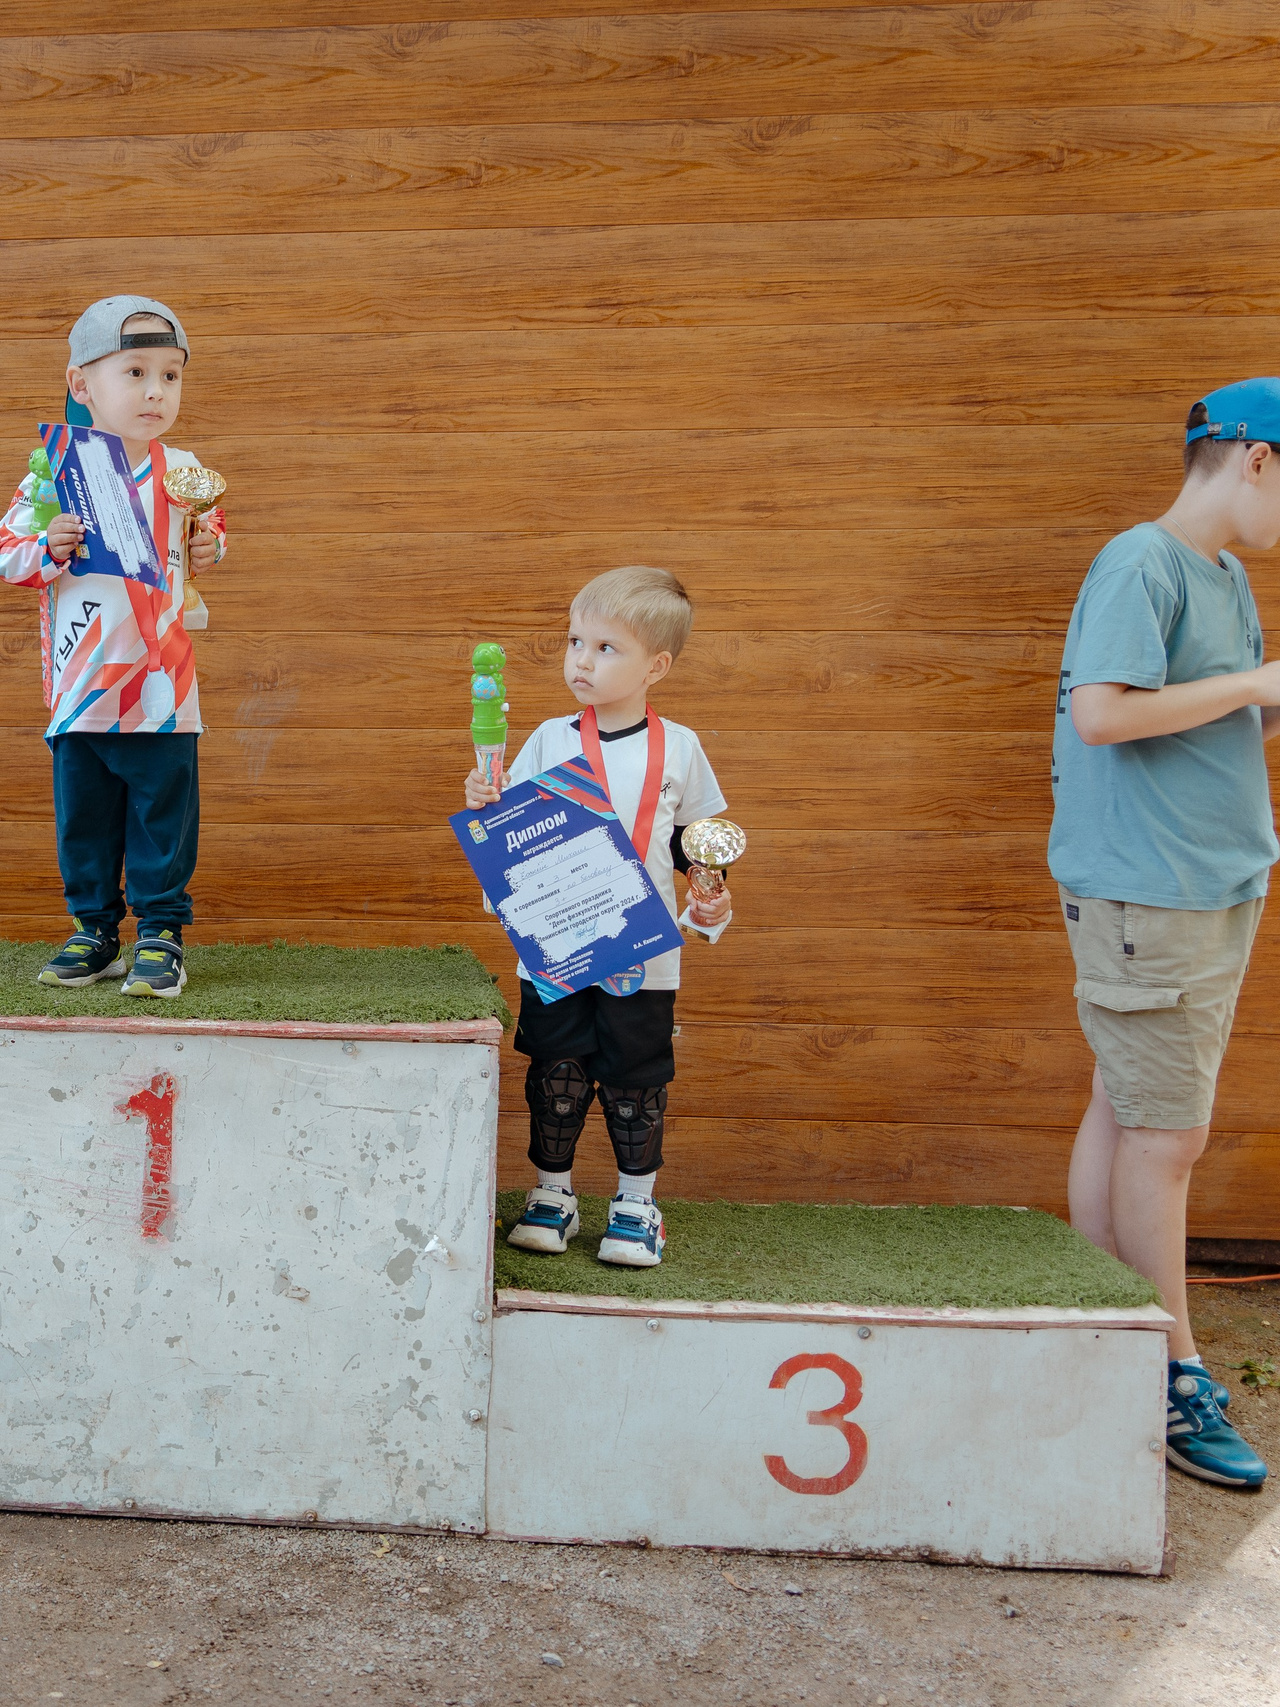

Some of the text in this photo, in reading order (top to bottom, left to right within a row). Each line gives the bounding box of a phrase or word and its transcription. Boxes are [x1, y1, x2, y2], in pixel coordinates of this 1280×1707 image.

[69, 467, 97, 535] Диплом
[505, 810, 568, 853] Диплом
[522, 834, 564, 858] награждается
[570, 863, 588, 874] место
[518, 889, 561, 912] соревнованиях
[537, 926, 569, 943] Ленинском
[569, 912, 600, 930] городском
[600, 903, 620, 916] округе
[620, 896, 634, 906] 2024
[544, 888, 612, 922] Спортивного праздника
[113, 1072, 176, 1239] 1
[763, 1352, 869, 1496] 3
